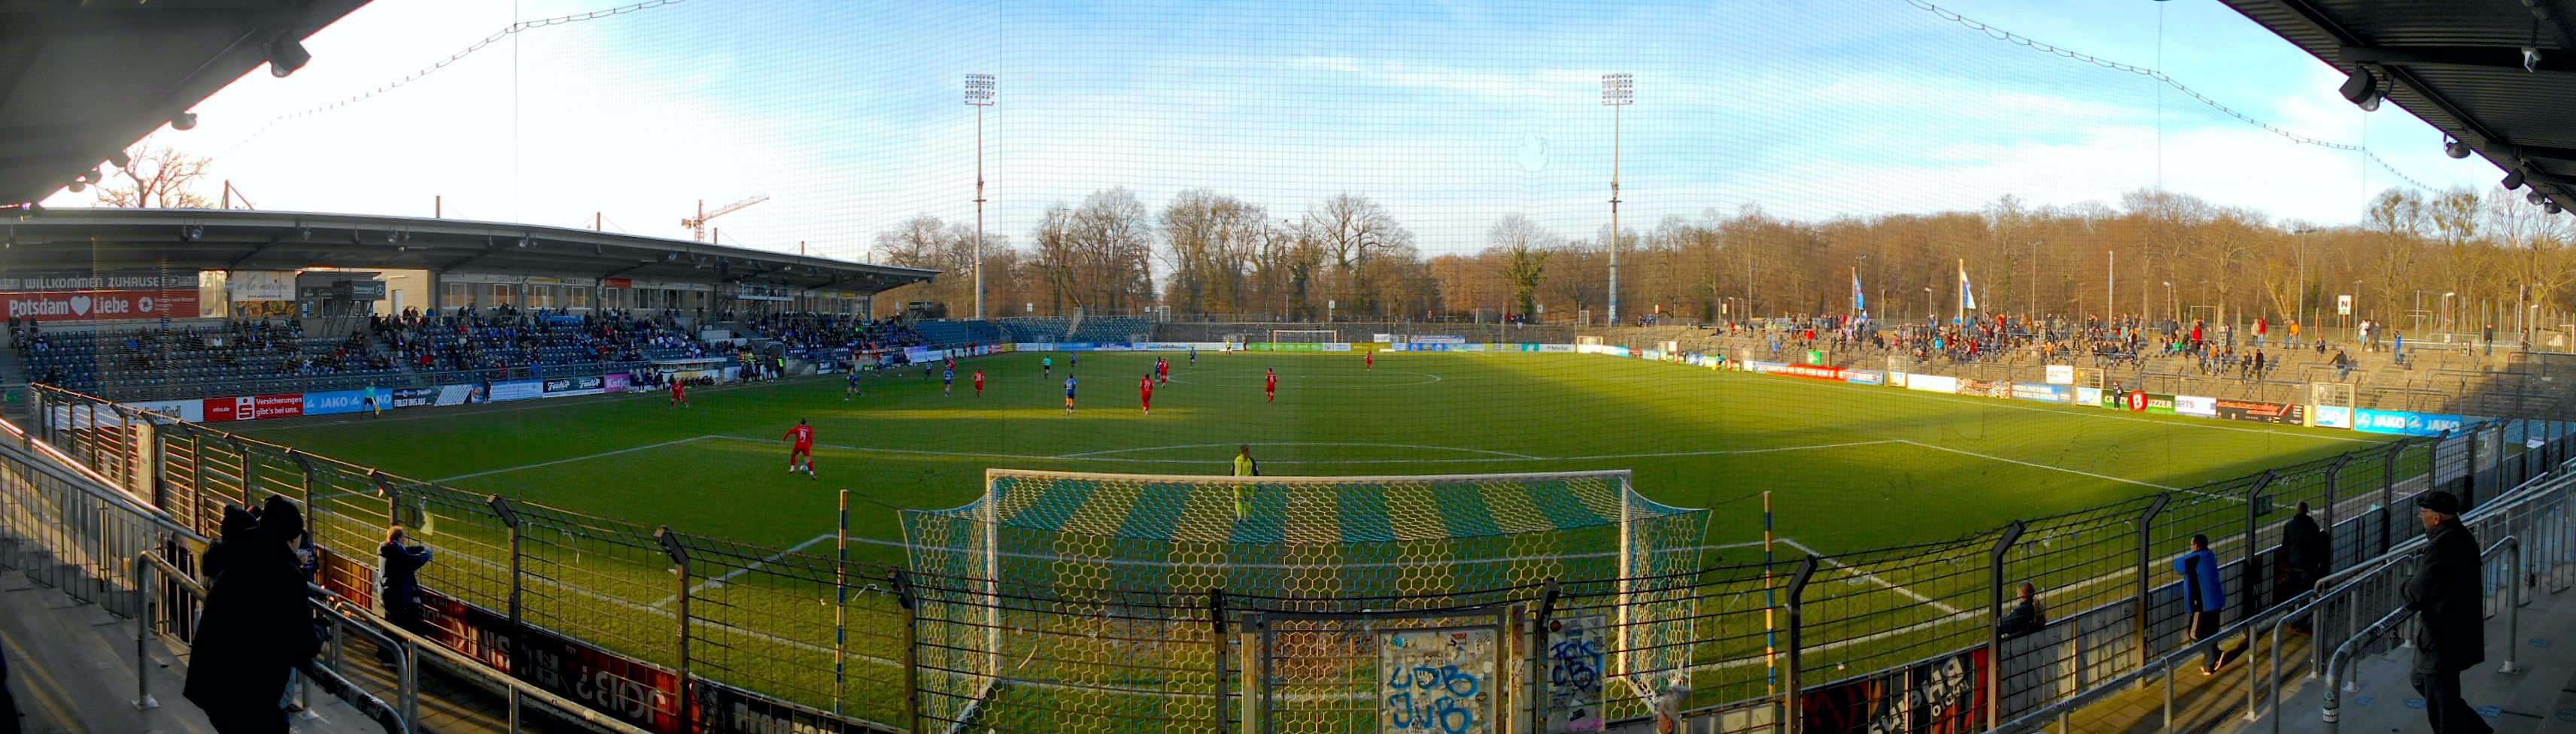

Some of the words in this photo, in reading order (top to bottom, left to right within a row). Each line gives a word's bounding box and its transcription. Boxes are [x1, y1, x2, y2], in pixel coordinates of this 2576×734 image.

[108, 276, 160, 287] ZUHAUSE
[9, 298, 69, 317] Potsdam
[93, 296, 129, 314] Liebe
[256, 397, 302, 405] Versicherungen
[319, 396, 348, 408] JAKO
[2104, 396, 2128, 405] CRZY
[256, 407, 273, 416] gibt's
[2374, 414, 2406, 429] JAKO
[2428, 419, 2461, 432] JAKO
